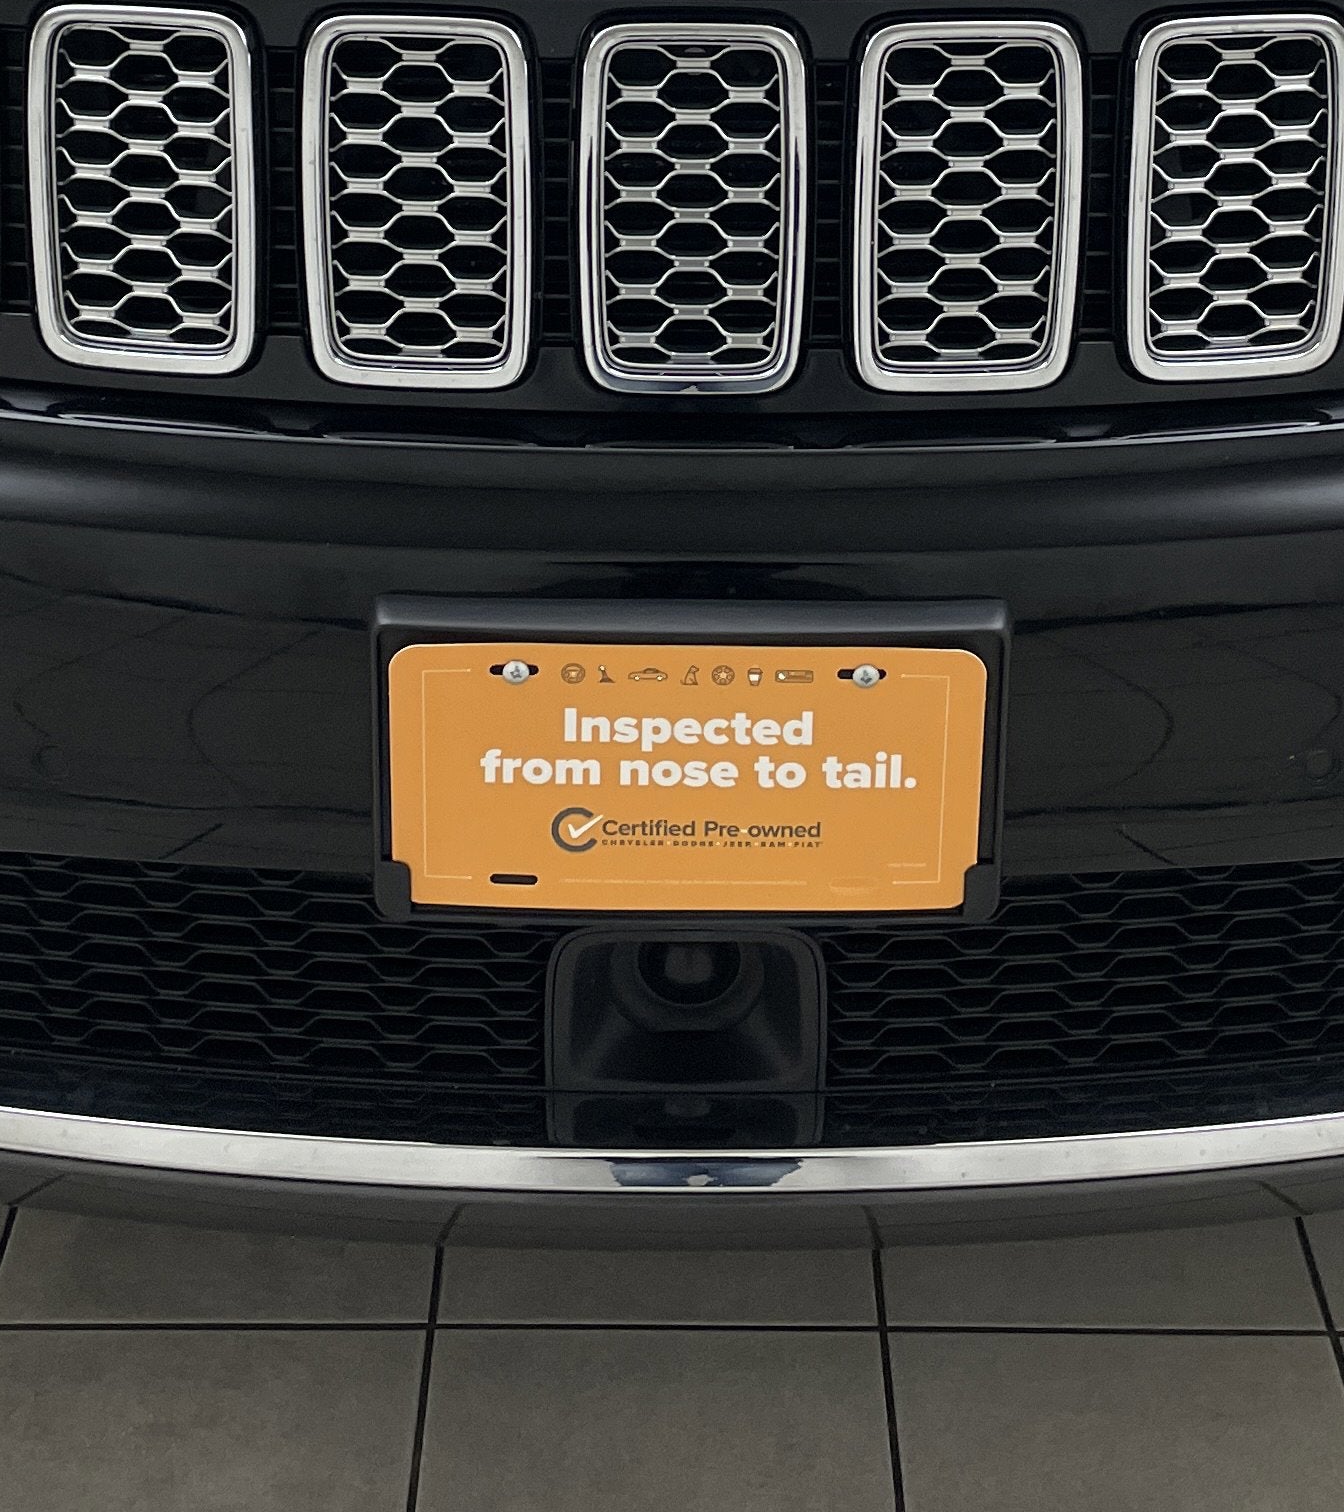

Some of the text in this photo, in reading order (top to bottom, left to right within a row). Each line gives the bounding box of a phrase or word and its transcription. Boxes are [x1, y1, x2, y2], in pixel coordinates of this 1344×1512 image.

[563, 707, 814, 752] Inspected
[479, 748, 917, 789] from nose to tail.
[601, 819, 696, 837] Certified
